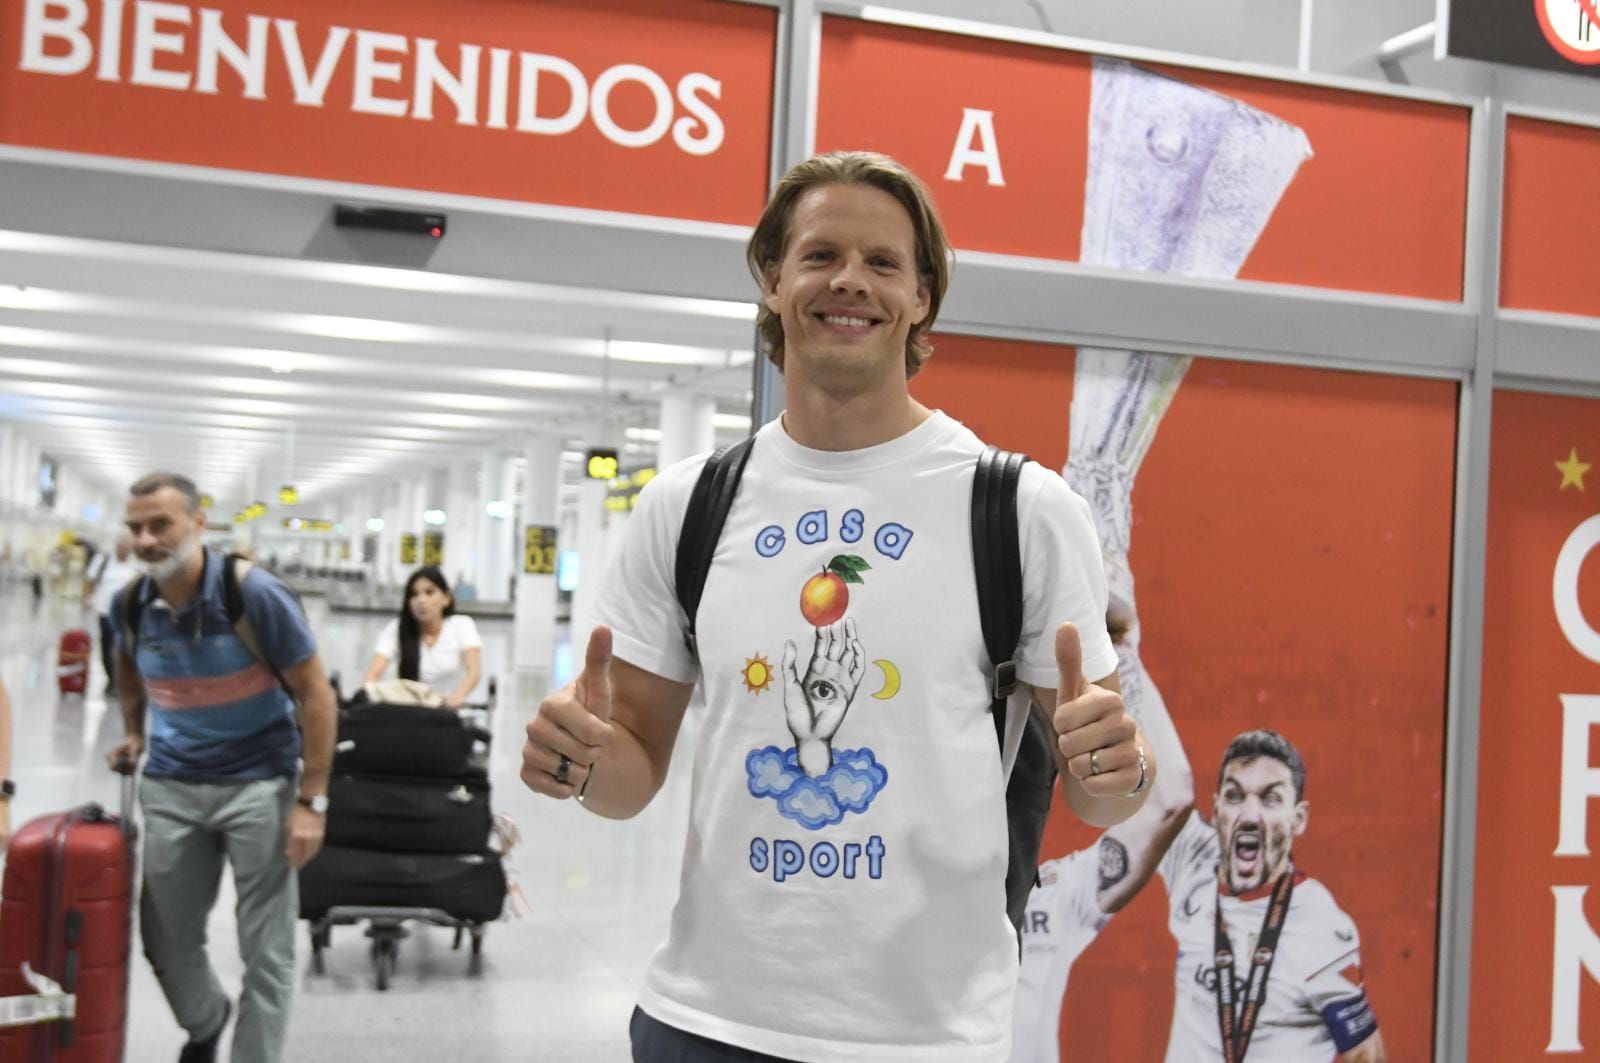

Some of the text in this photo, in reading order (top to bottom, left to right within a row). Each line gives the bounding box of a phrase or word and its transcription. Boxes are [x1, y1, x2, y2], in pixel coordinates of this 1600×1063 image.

[18, 0, 1007, 187] BIENVENIDOS A
[755, 508, 914, 560] casa
[749, 835, 886, 882] sport
[1023, 910, 1050, 934] IR
